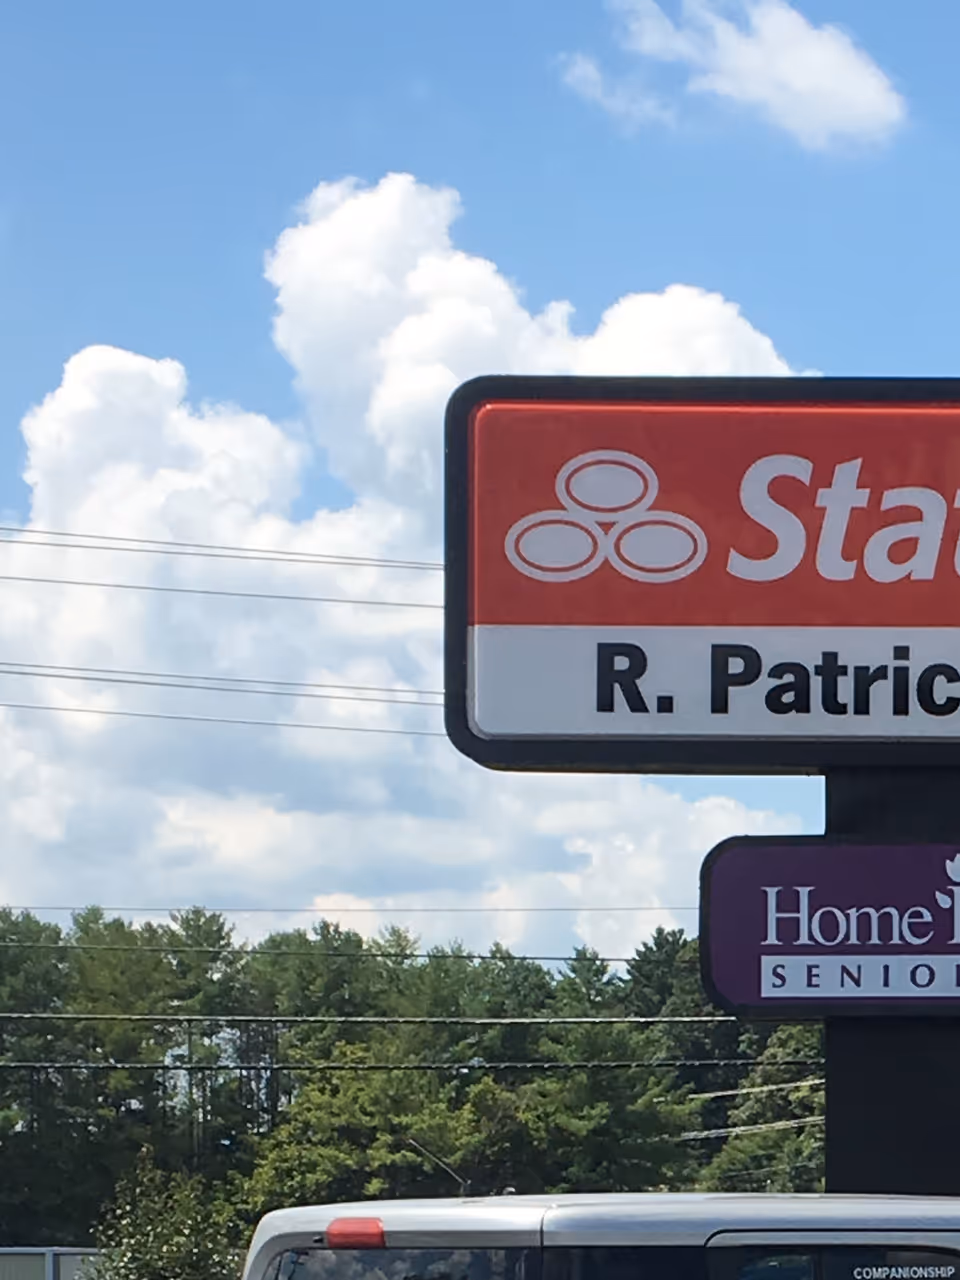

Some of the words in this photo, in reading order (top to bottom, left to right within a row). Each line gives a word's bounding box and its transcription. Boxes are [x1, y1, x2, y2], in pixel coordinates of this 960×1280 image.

[596, 643, 674, 715] R.
[760, 886, 935, 946] Home
[853, 1266, 955, 1280] COMPANIONSHIP
